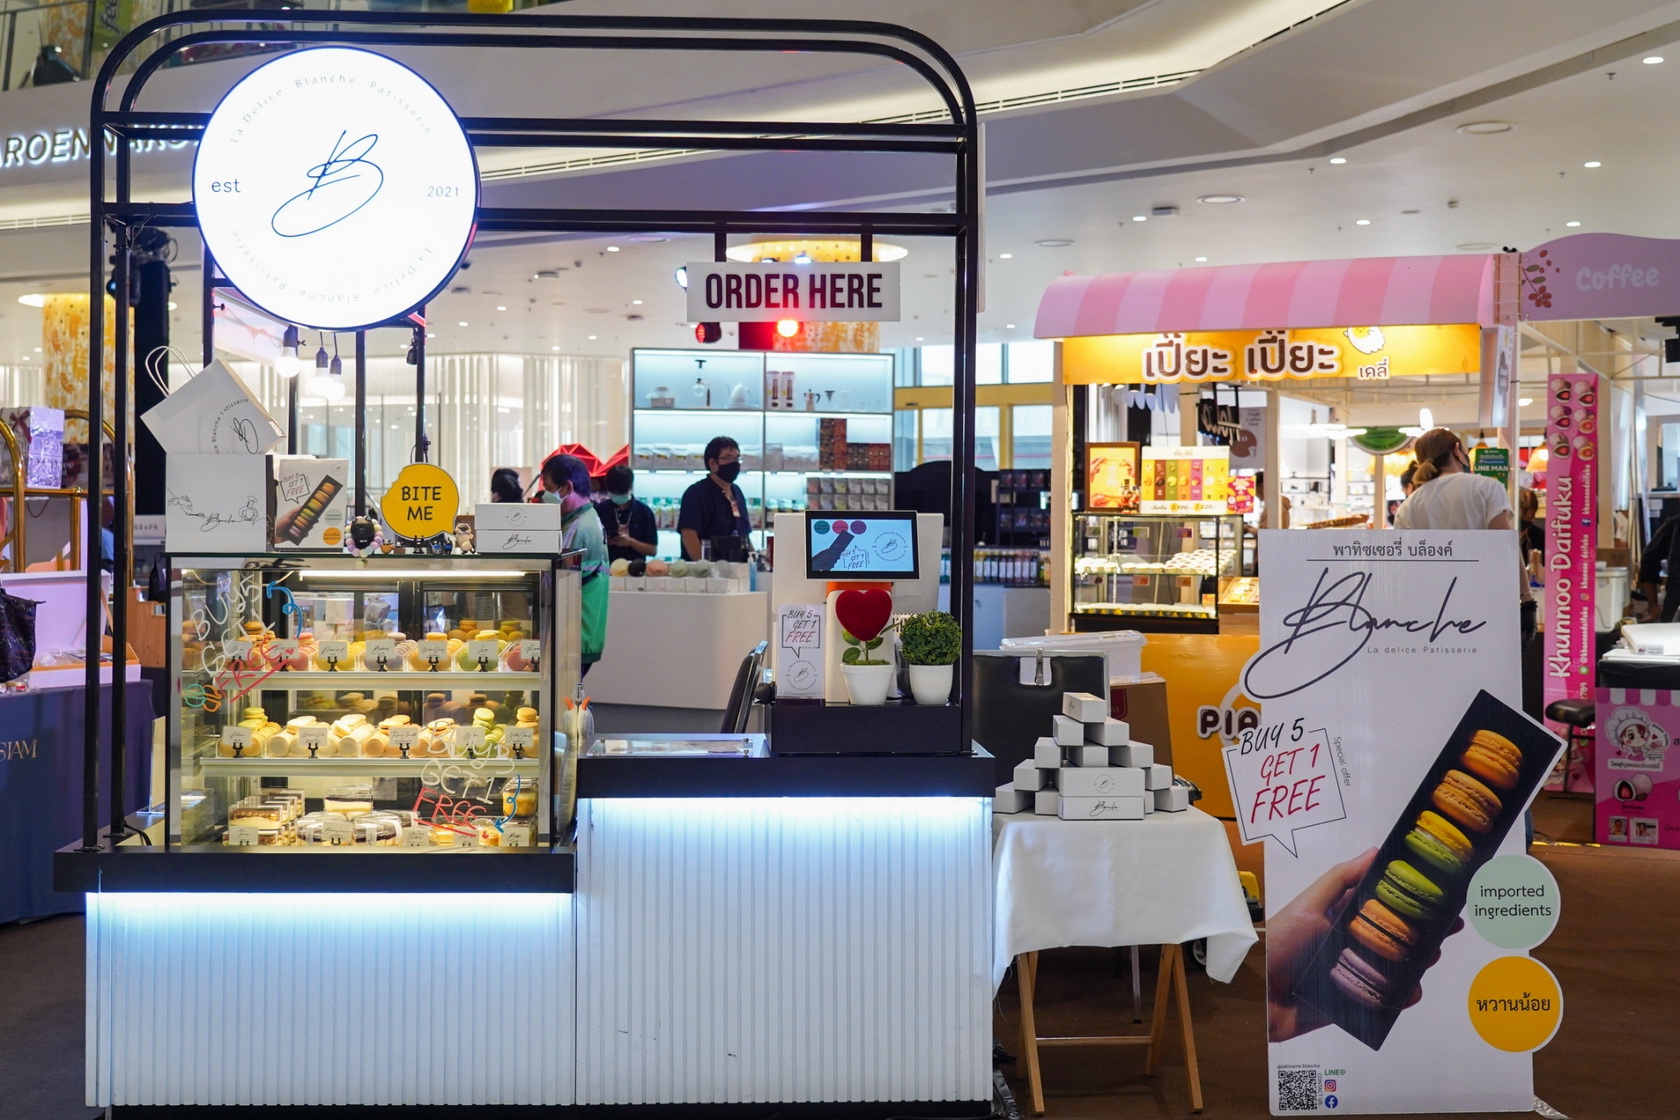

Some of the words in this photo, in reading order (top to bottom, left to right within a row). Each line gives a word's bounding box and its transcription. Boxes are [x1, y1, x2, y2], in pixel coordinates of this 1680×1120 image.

[295, 74, 355, 88] Blanche
[212, 177, 241, 193] est
[427, 185, 460, 197] 2021
[1576, 264, 1660, 291] Coffee
[705, 272, 800, 309] ORDER
[809, 272, 883, 309] HERE
[287, 484, 304, 497] FREE
[401, 486, 442, 501] BITE
[407, 506, 433, 520] ME
[1549, 475, 1572, 573] Daifuku
[1407, 539, 1453, 557] บล็องค์
[847, 560, 864, 569] FREE
[787, 609, 805, 619] BUY
[806, 609, 814, 619] 5
[793, 620, 811, 631] GET
[811, 620, 817, 629] 1
[1547, 578, 1573, 678] Khunnoo
[785, 631, 816, 643] FREE
[202, 615, 252, 678] GET
[1367, 646, 1379, 654] La
[1384, 646, 1417, 654] delice
[1423, 646, 1478, 654] Patisserie
[215, 636, 284, 698] FREE
[1200, 709, 1258, 735] PIA
[1241, 723, 1285, 756] BUY
[1291, 717, 1305, 742] 5
[1260, 747, 1305, 787] GET
[1310, 743, 1320, 768] 1
[1333, 736, 1347, 767] Special
[1341, 767, 1351, 787] offer
[1251, 775, 1326, 824] FREE
[1480, 885, 1545, 900] imported
[1475, 904, 1552, 919] ingredients
[1476, 992, 1551, 1011] หวานน้อย
